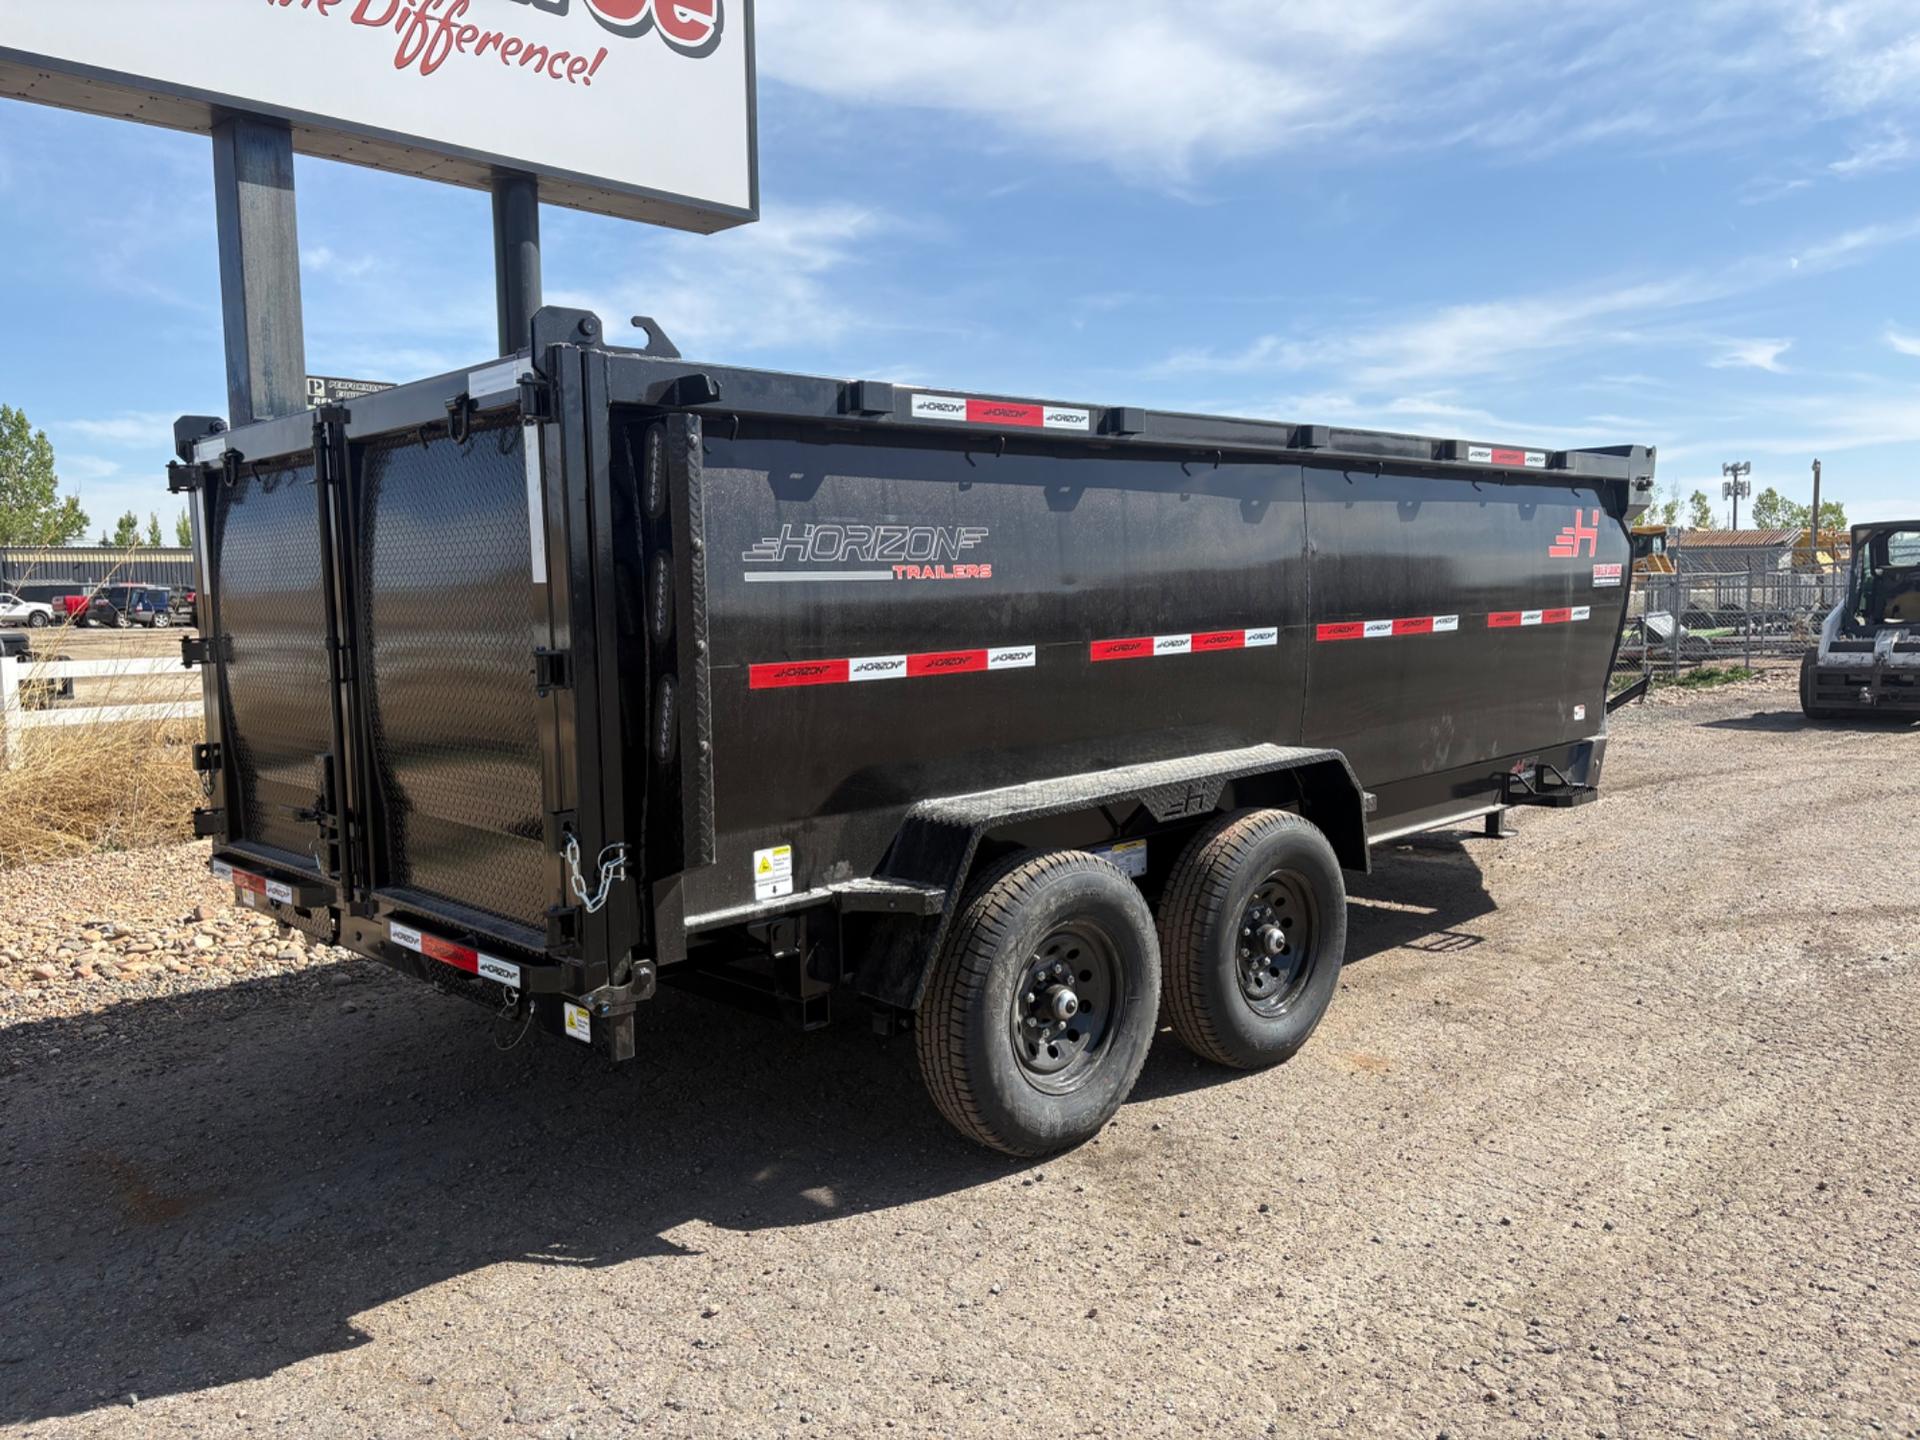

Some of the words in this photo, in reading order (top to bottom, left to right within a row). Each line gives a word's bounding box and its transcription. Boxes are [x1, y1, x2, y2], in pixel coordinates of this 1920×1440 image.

[916, 401, 965, 413] HORIZON
[773, 523, 966, 562] HORIZON
[892, 564, 992, 580] TRAILERS
[773, 665, 831, 679] HORIZON
[853, 660, 906, 673] HORIZON
[925, 656, 973, 668] HORIZON
[990, 651, 1034, 663] HORIZON
